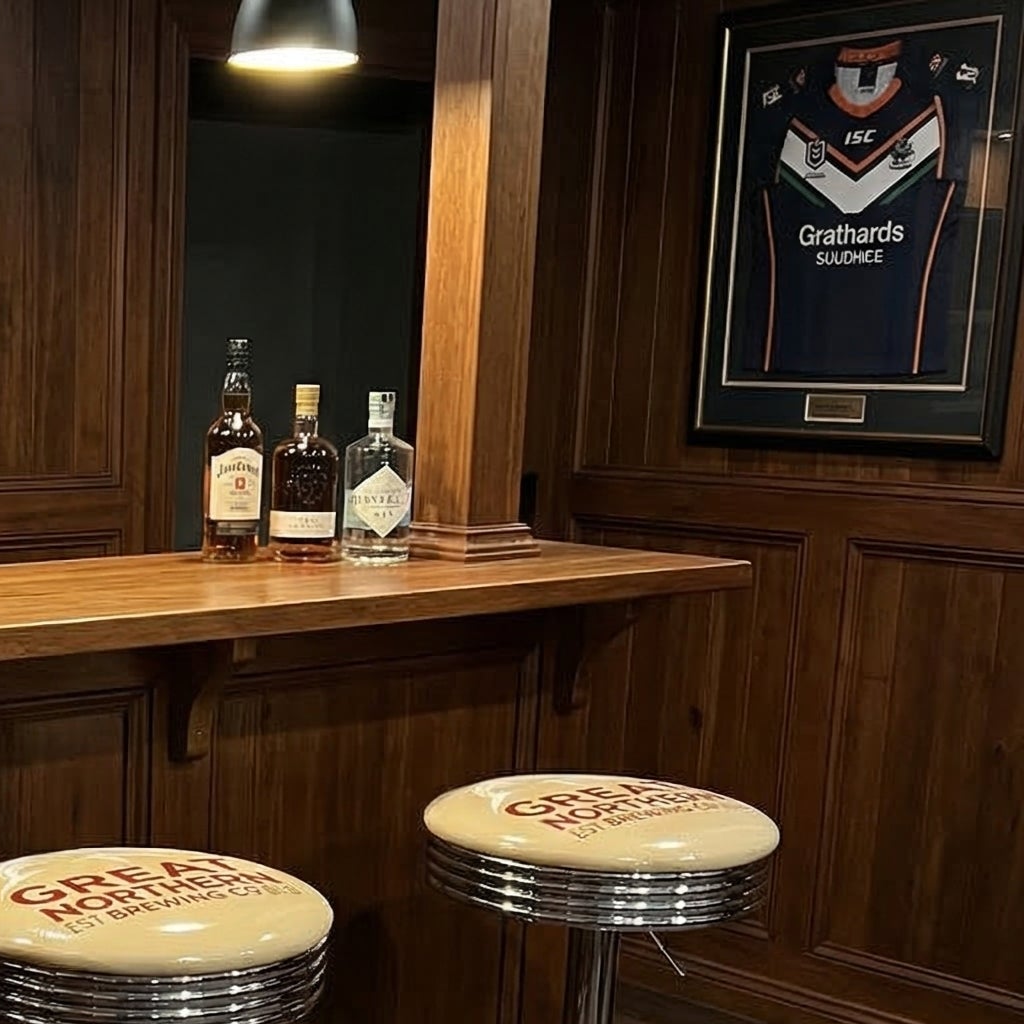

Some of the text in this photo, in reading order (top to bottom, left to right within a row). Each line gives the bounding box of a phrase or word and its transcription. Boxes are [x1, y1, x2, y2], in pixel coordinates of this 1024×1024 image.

[844, 129, 877, 145] ISC
[799, 220, 904, 246] Grathards
[504, 781, 679, 816] GREAT
[10, 858, 237, 906] GREAT
[39, 871, 283, 923] NORTHERN
[64, 914, 105, 934] EST
[106, 889, 229, 920] BREWING
